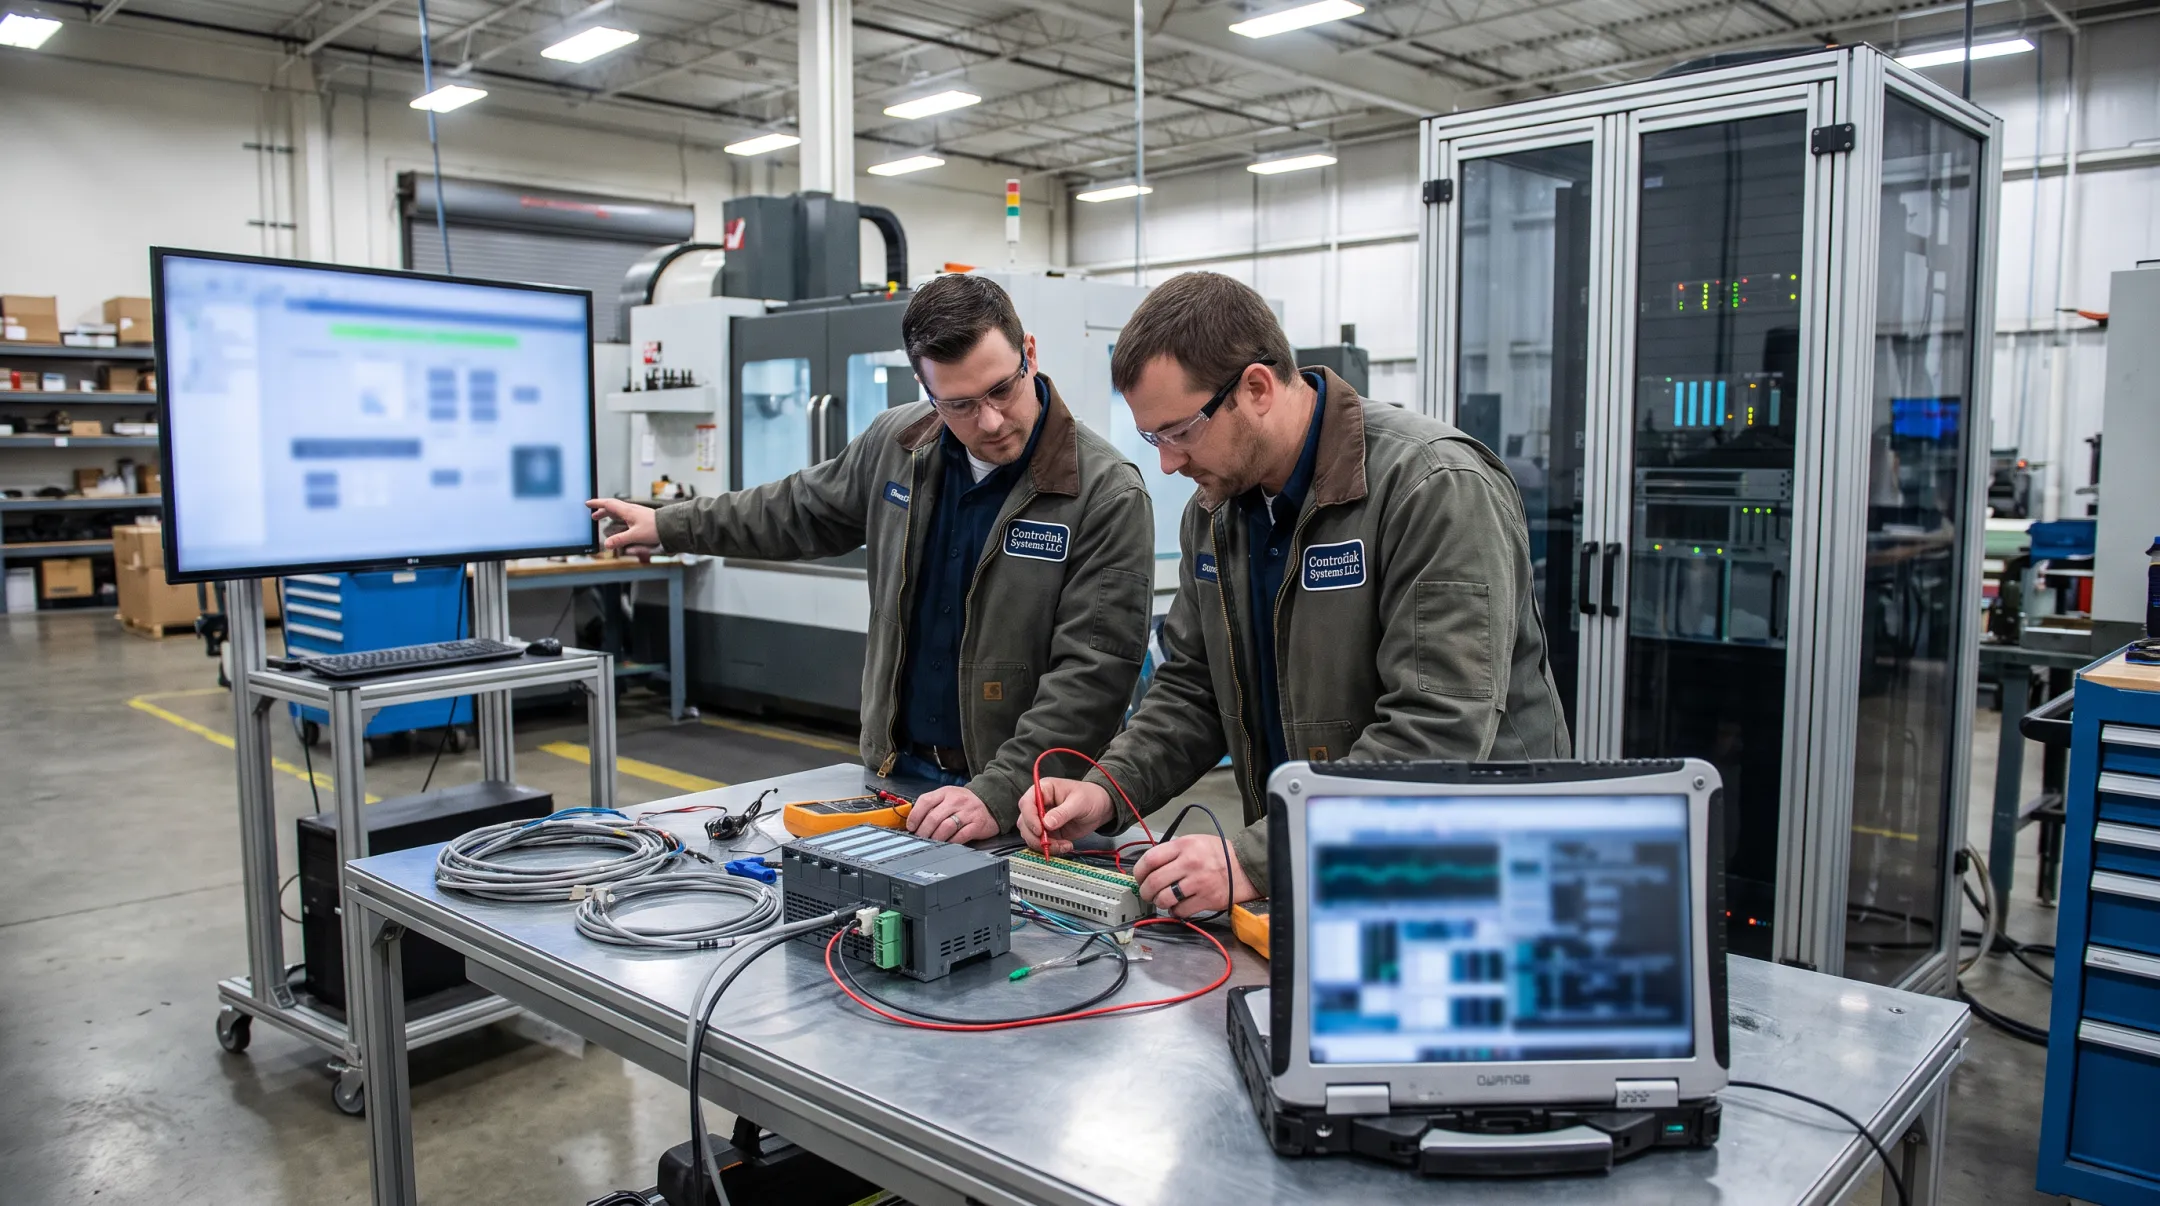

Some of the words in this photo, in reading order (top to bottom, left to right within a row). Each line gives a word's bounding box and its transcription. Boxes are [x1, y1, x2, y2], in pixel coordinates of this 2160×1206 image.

[1010, 539, 1044, 550] Systems
[1045, 543, 1062, 552] LLC
[1310, 569, 1343, 581] Systems
[1344, 564, 1360, 576] LLC
